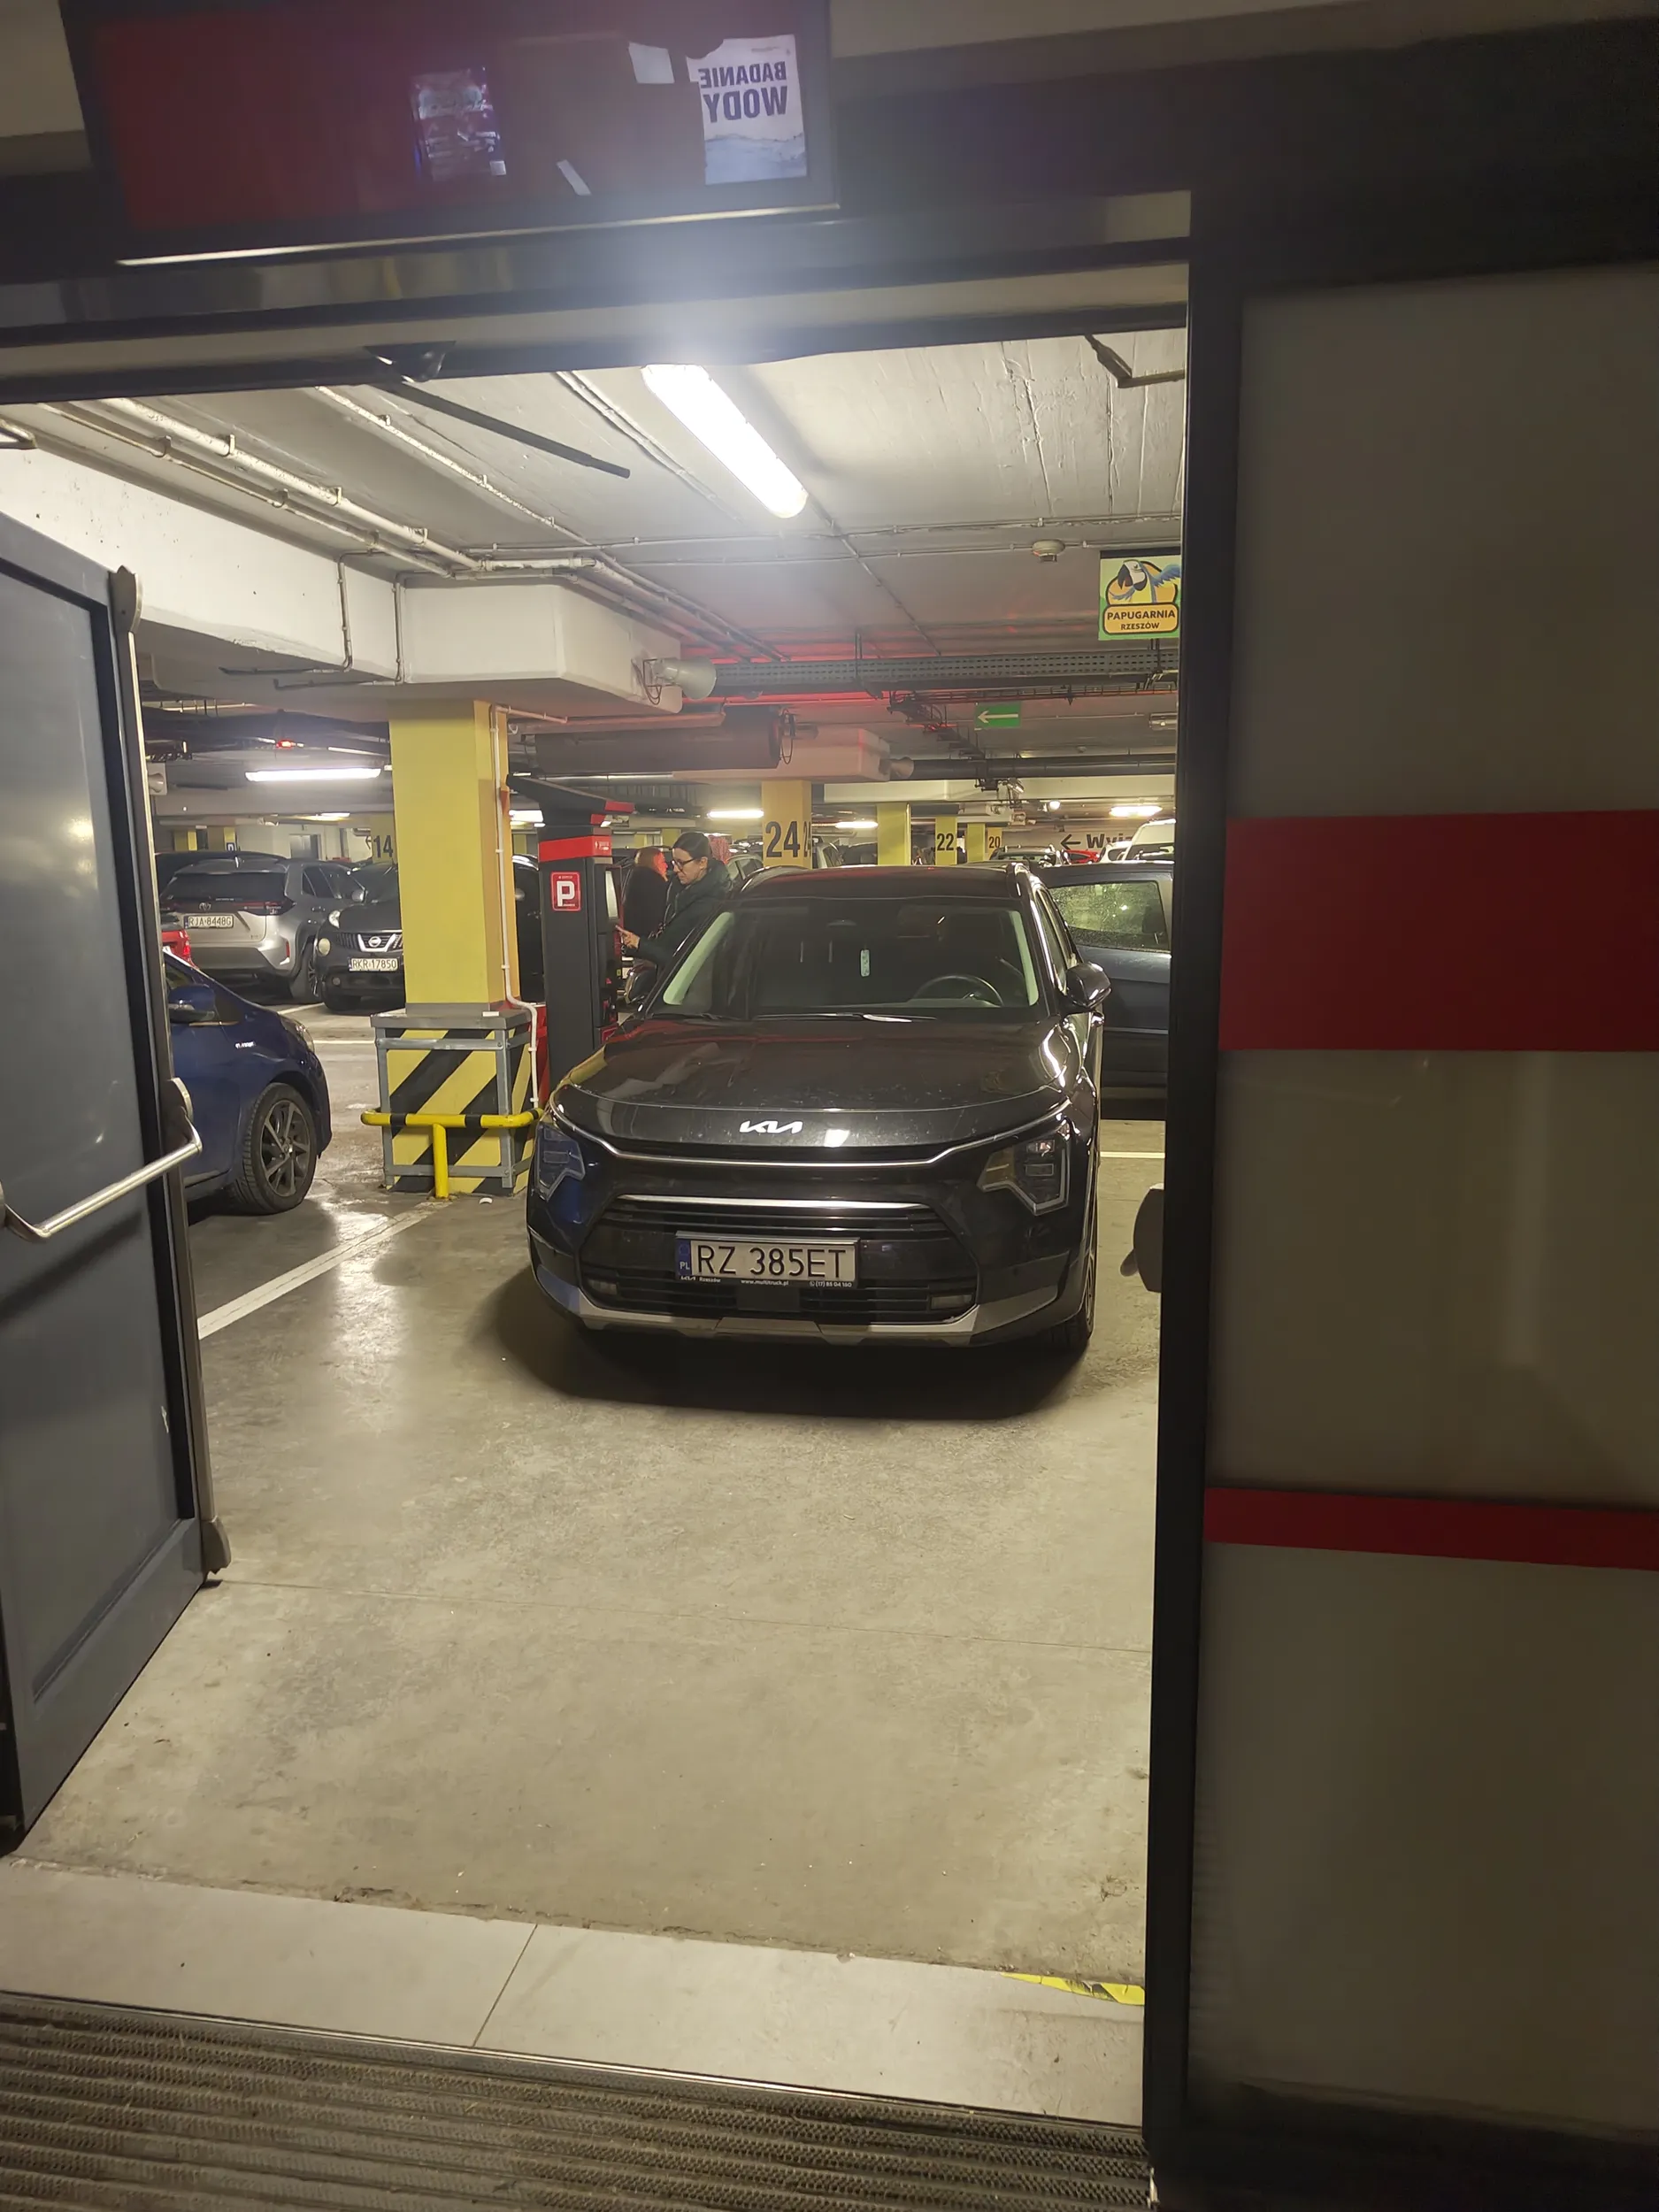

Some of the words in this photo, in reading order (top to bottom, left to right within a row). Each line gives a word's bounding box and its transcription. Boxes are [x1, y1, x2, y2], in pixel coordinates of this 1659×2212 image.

[1107, 610, 1175, 620] PAPUGARNIA
[1121, 621, 1160, 630] RZESZÓW
[373, 835, 393, 857] 14
[765, 821, 800, 857] 24
[937, 833, 954, 850] 22
[989, 836, 1001, 849] 20
[557, 880, 575, 907] P
[740, 1120, 803, 1133] KIA
[680, 1261, 690, 1270] PL
[697, 1245, 736, 1275] RZ
[749, 1248, 846, 1279] 385ET
